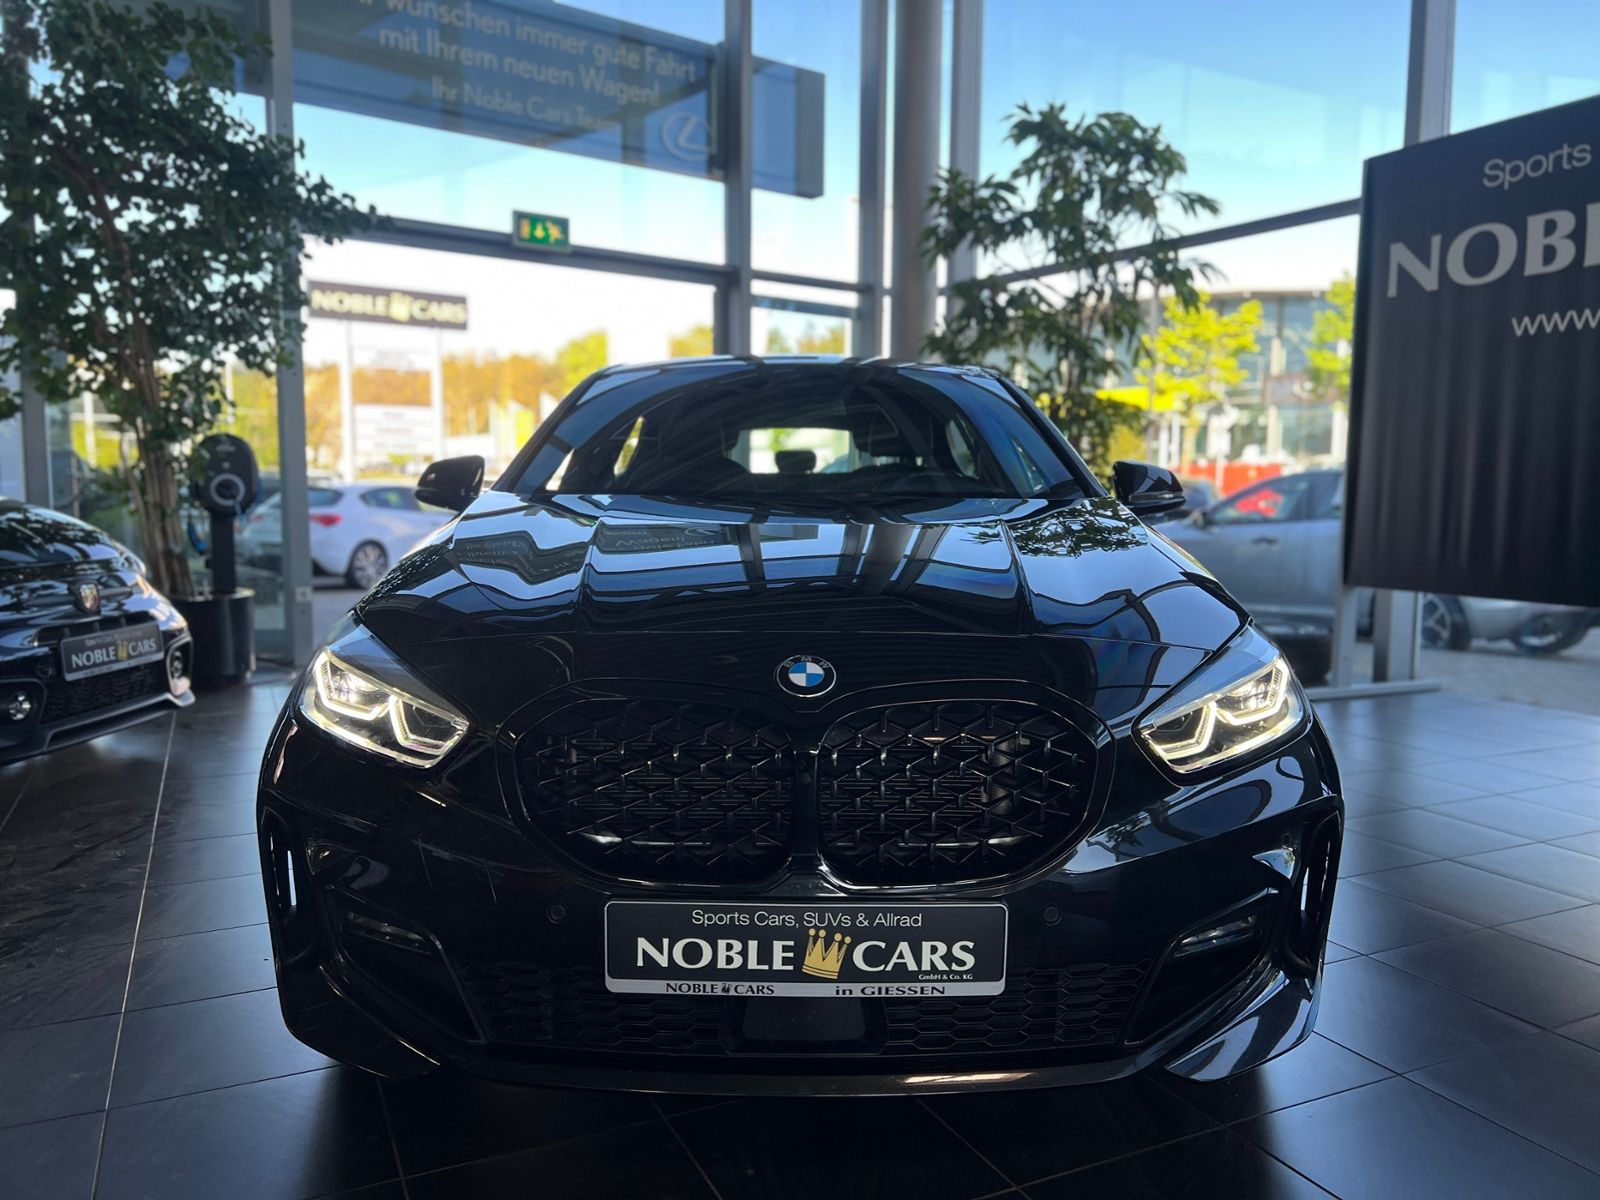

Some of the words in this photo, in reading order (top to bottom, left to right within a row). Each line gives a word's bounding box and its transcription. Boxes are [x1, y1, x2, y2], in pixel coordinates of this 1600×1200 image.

[379, 27, 419, 53] mit
[427, 27, 498, 70] Ihrem
[504, 53, 575, 88] neuen
[515, 17, 588, 55] immer
[594, 43, 640, 70] gute
[645, 46, 697, 81] Fahrt
[431, 76, 460, 101] Ihr
[463, 81, 525, 116] Noble
[526, 96, 572, 125] Cars
[1483, 143, 1593, 190] Sports
[311, 289, 389, 315] NOBLE
[412, 299, 467, 323] CARS
[71, 646, 116, 668] NOBLE
[128, 638, 157, 656] CARS
[692, 910, 750, 927] Sports
[754, 911, 800, 928] Cars,
[803, 912, 852, 927] SUVs
[855, 912, 870, 927] &
[873, 912, 922, 927] Allrad
[636, 937, 795, 971] NOBLE
[852, 940, 976, 972] CARS
[665, 982, 719, 994] NOBLE
[734, 984, 775, 995] CARS
[835, 986, 853, 996] in
[860, 986, 946, 996] GIESSEN
[918, 973, 941, 981] GmbH
[949, 973, 962, 981] Co.
[962, 973, 974, 981] KG
